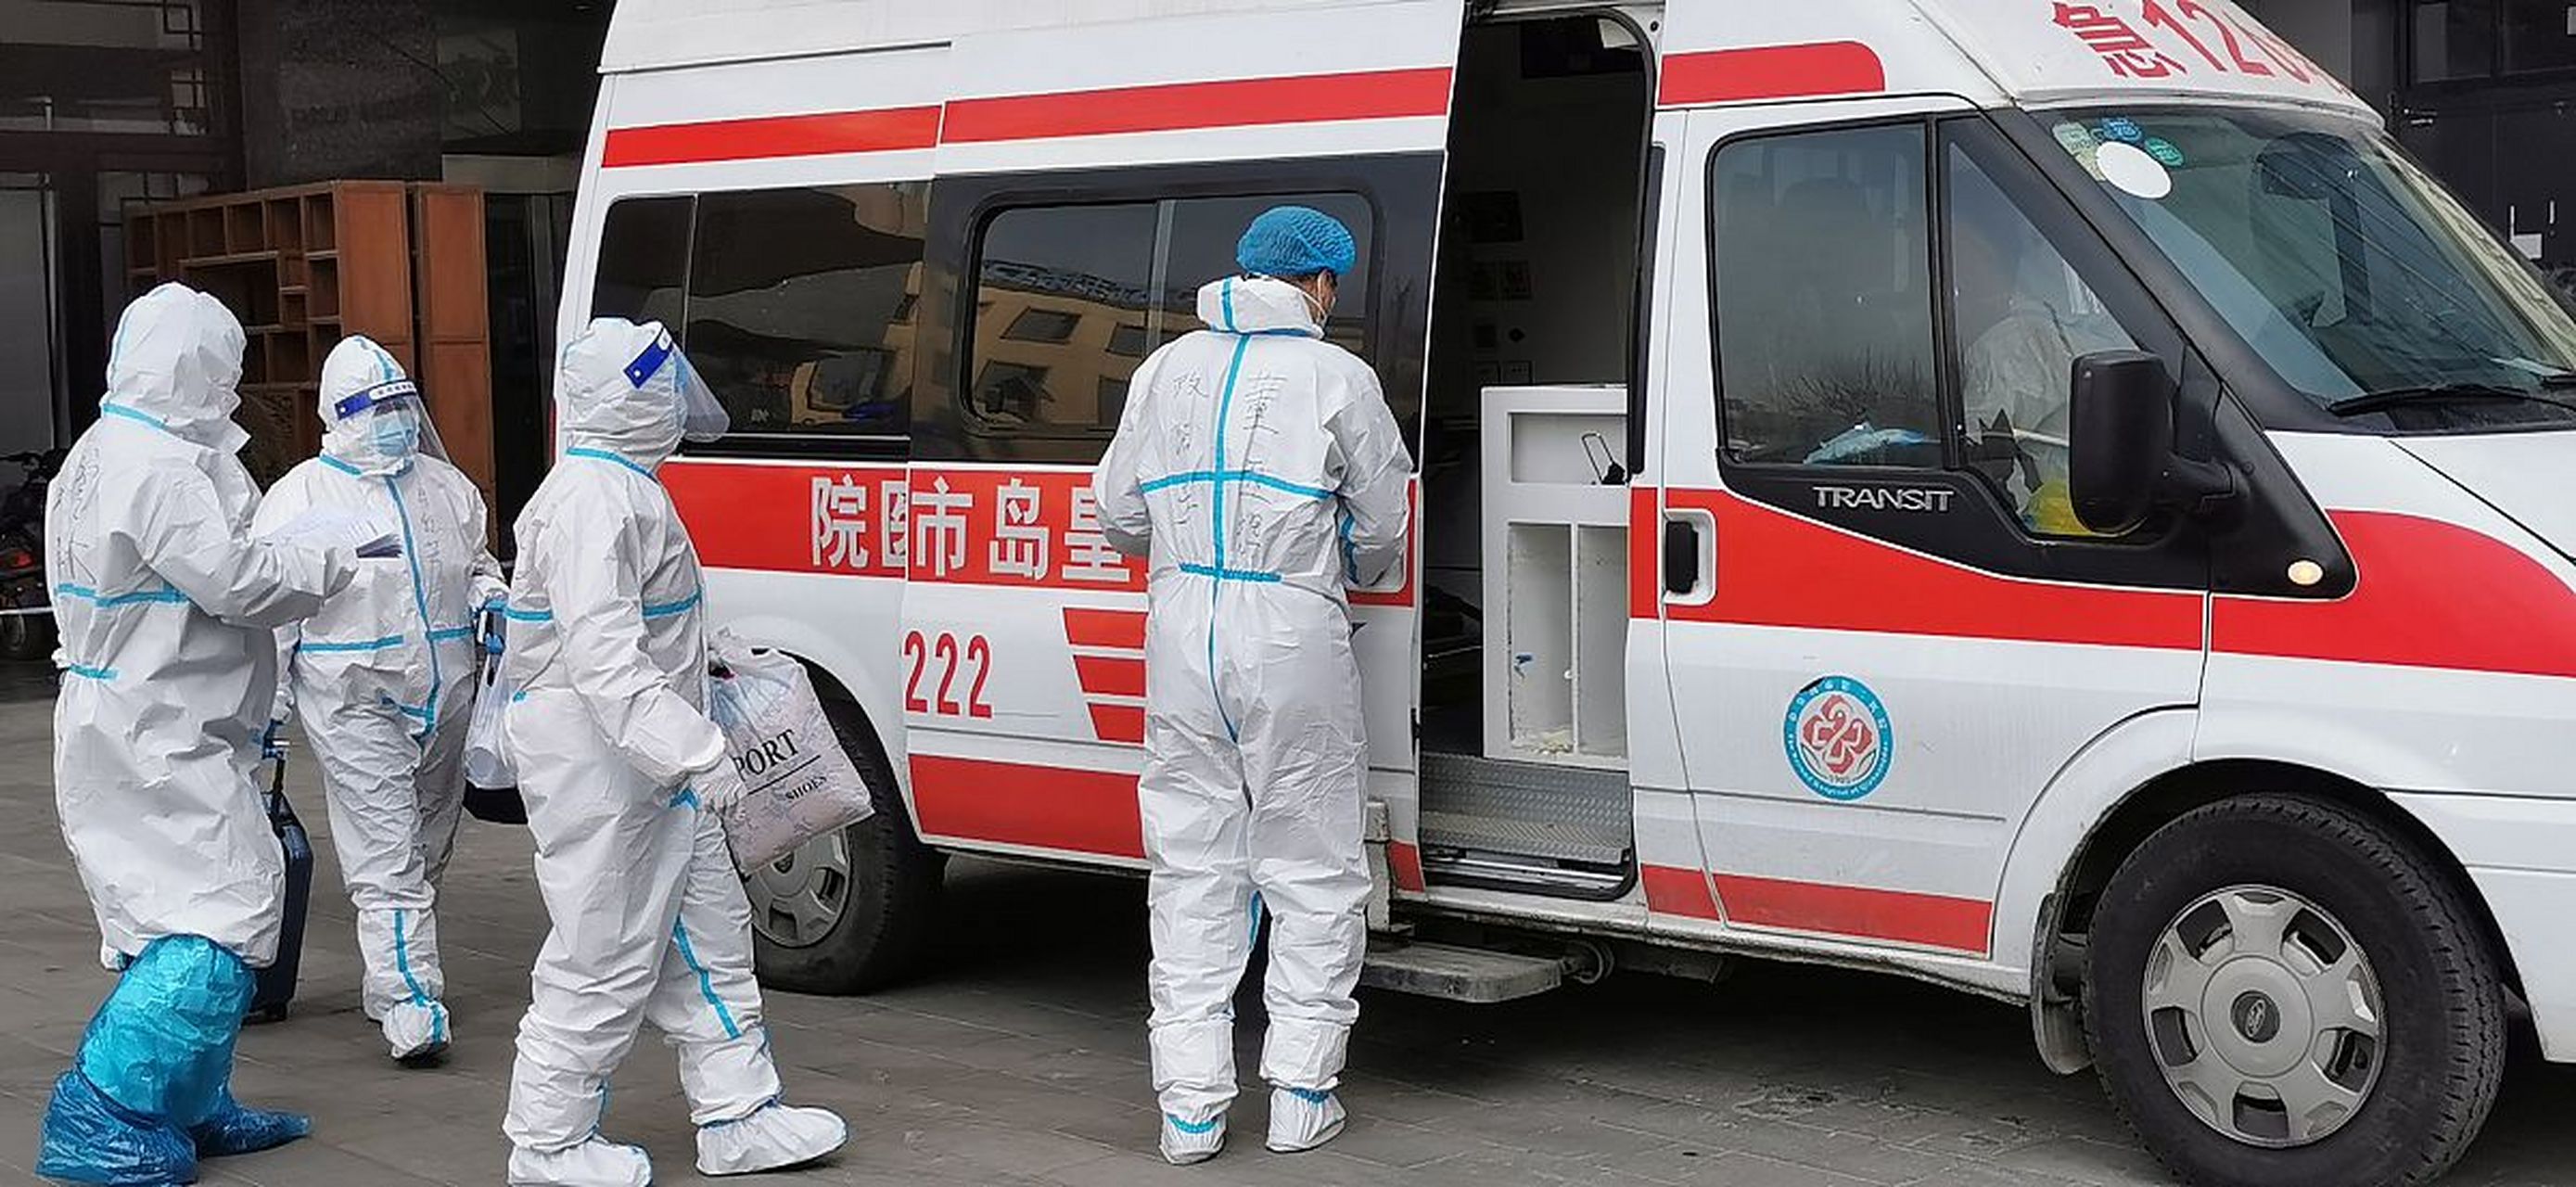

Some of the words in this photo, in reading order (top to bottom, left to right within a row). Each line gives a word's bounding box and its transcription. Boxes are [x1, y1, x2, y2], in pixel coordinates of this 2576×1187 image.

[1812, 485, 1955, 511] TRANSIT
[903, 630, 992, 719] 222
[784, 774, 828, 803] SHOES
